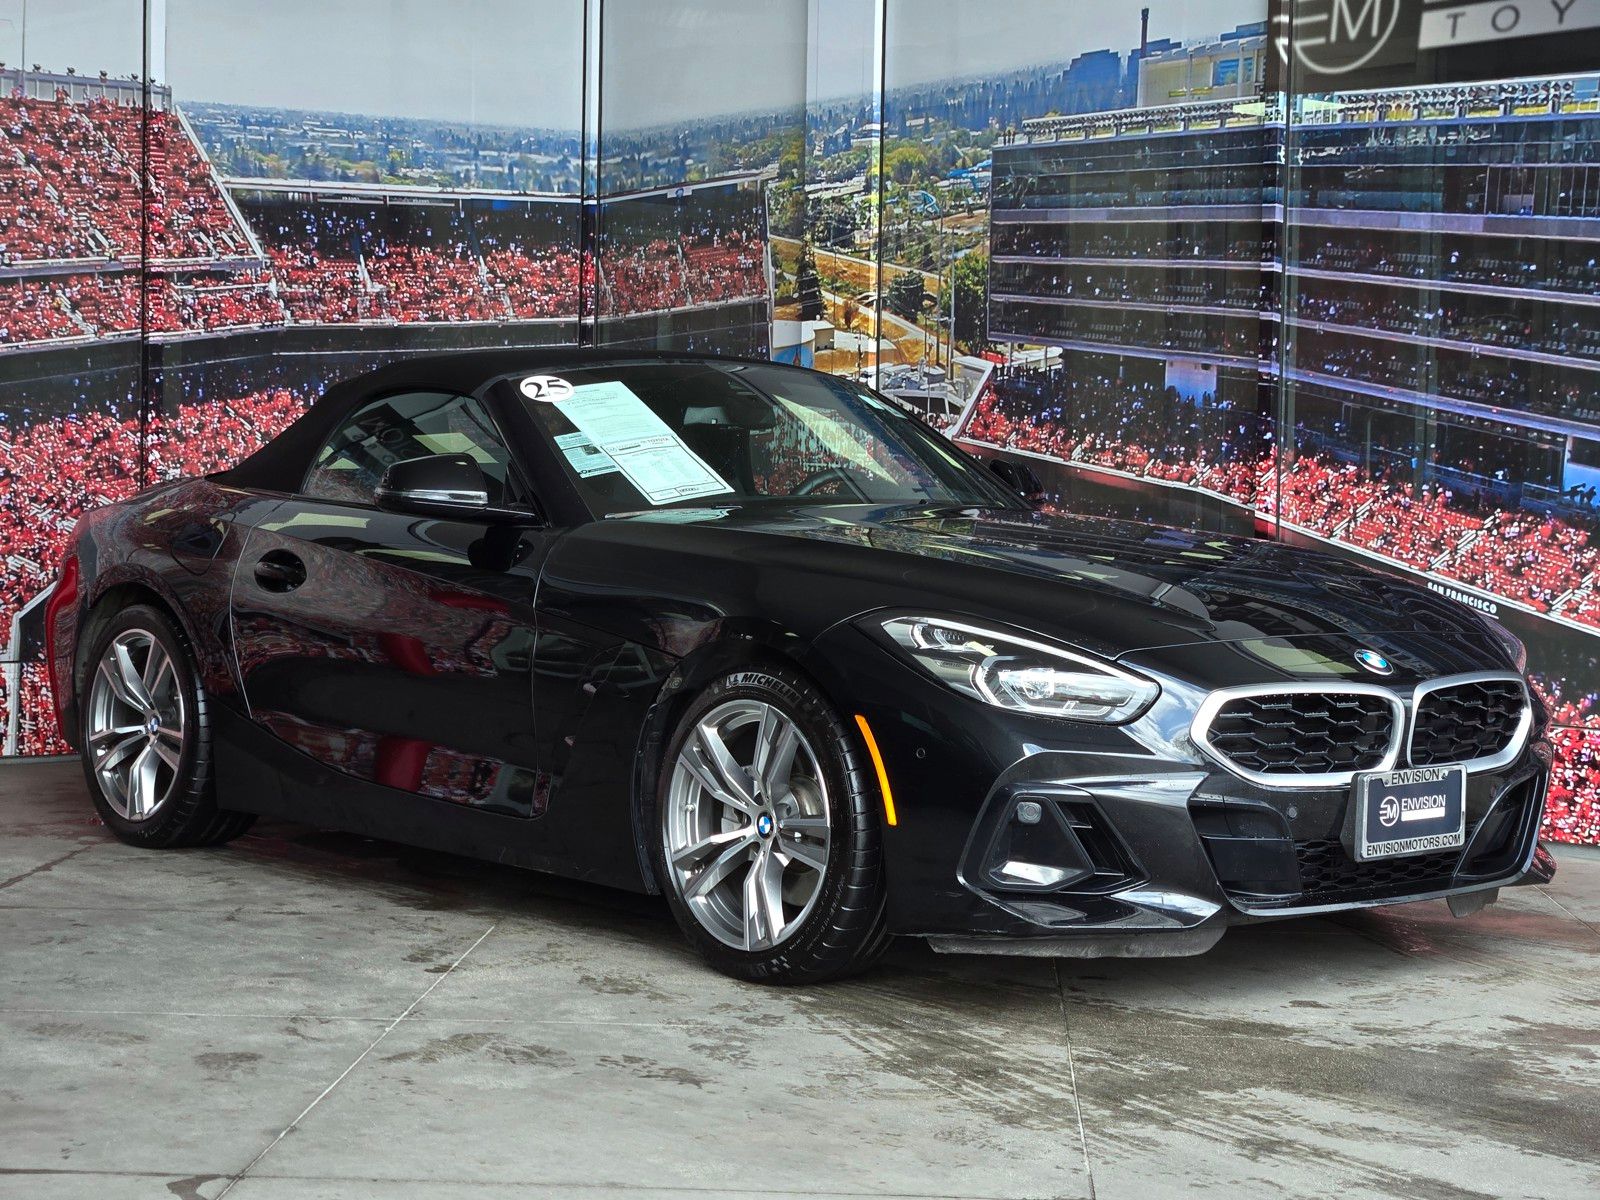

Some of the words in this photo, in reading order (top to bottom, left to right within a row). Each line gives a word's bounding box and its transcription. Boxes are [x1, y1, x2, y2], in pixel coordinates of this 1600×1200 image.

[524, 379, 569, 399] 25
[1427, 581, 1444, 595] SAN
[1445, 588, 1498, 614] FRANCISCO
[741, 673, 801, 704] MICHELIN
[1391, 768, 1440, 785] ENVISION
[1401, 794, 1447, 811] ENVISION
[1366, 833, 1461, 856] ENVISIONMOTORS.COM
